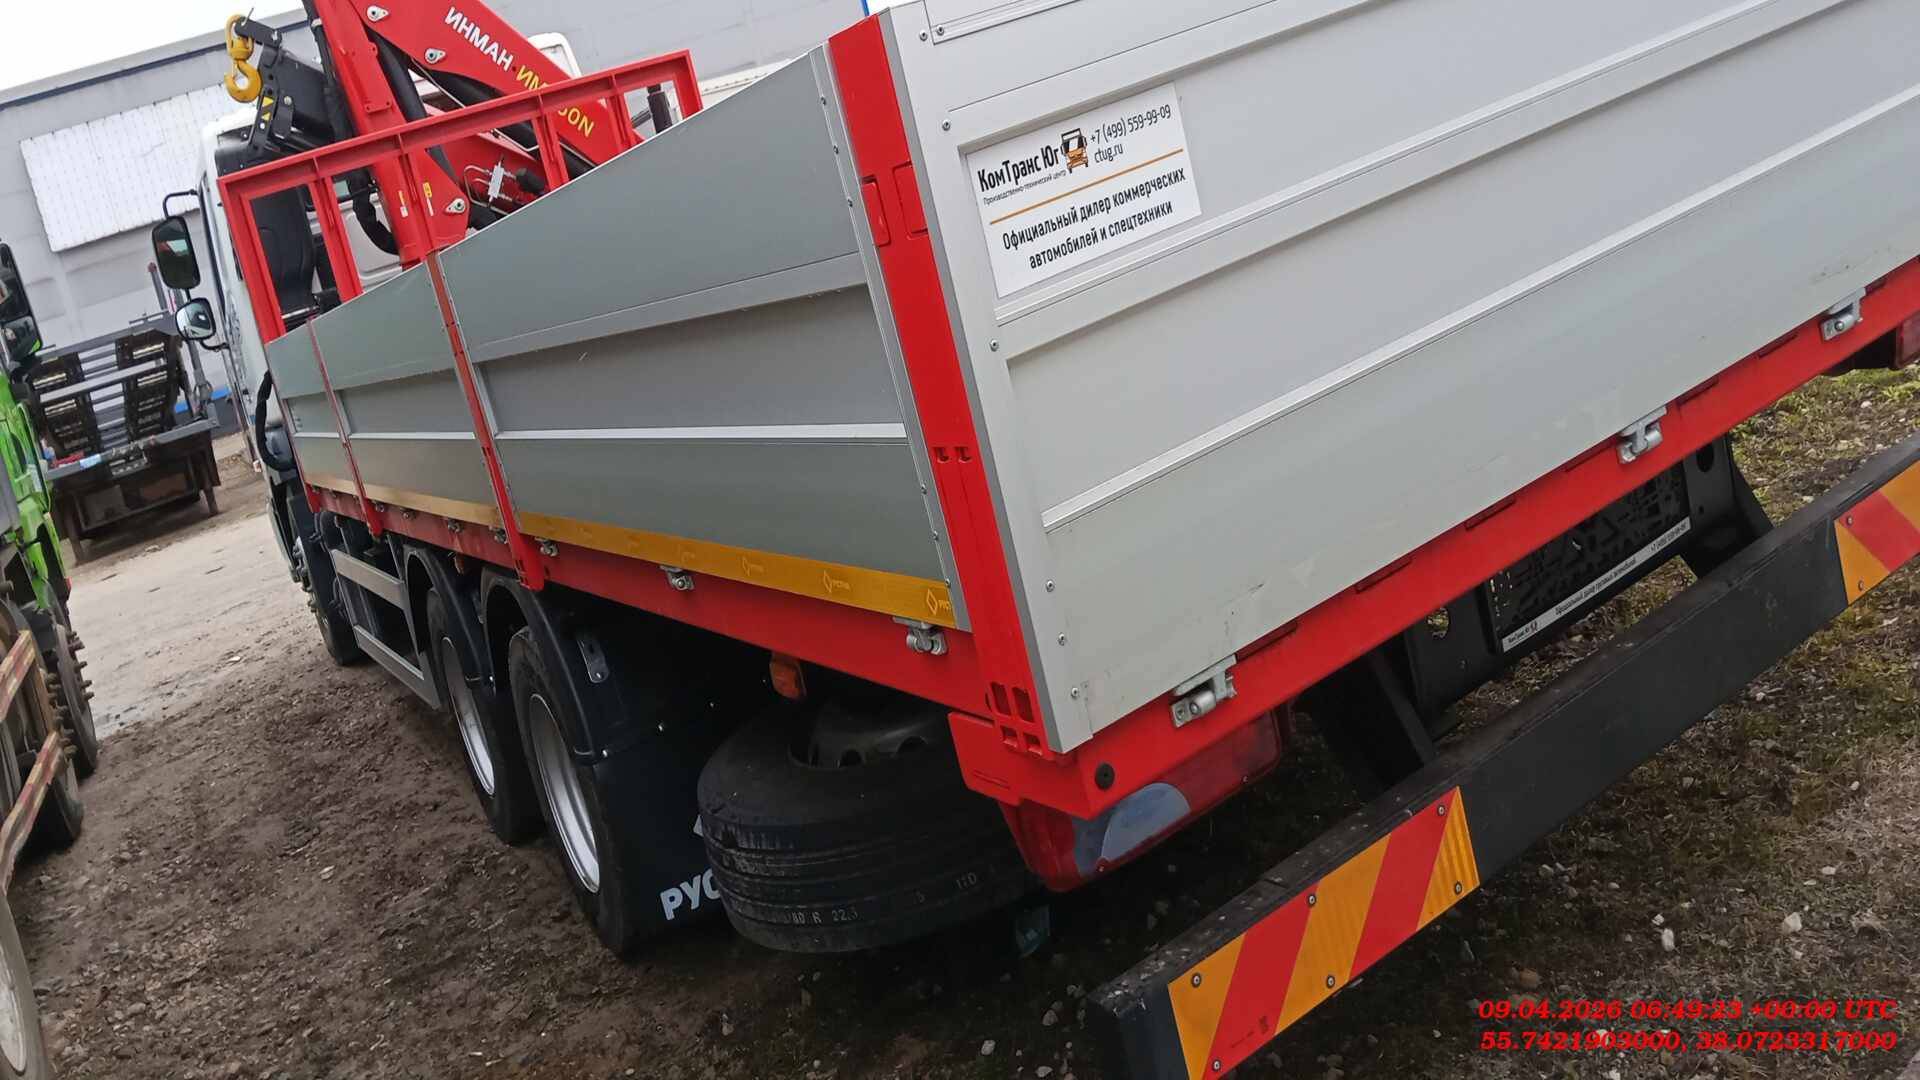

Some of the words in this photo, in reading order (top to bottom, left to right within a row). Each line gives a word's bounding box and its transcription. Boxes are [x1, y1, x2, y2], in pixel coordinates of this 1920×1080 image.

[445, 7, 514, 71] ИНМАН
[1090, 129, 1100, 144] +7
[1103, 117, 1126, 143] (499)
[1127, 104, 1171, 133] 559-99-09
[977, 155, 1042, 192] КомТранс
[1040, 145, 1059, 169] Юг
[1094, 144, 1123, 163] ctug.ru
[1002, 206, 1079, 250] Официальный
[1080, 197, 1111, 223] дилер
[1112, 168, 1186, 207] коммерческих
[1029, 227, 1099, 269] автомобилей
[1099, 226, 1108, 241] и
[1107, 201, 1173, 238] спецтехники
